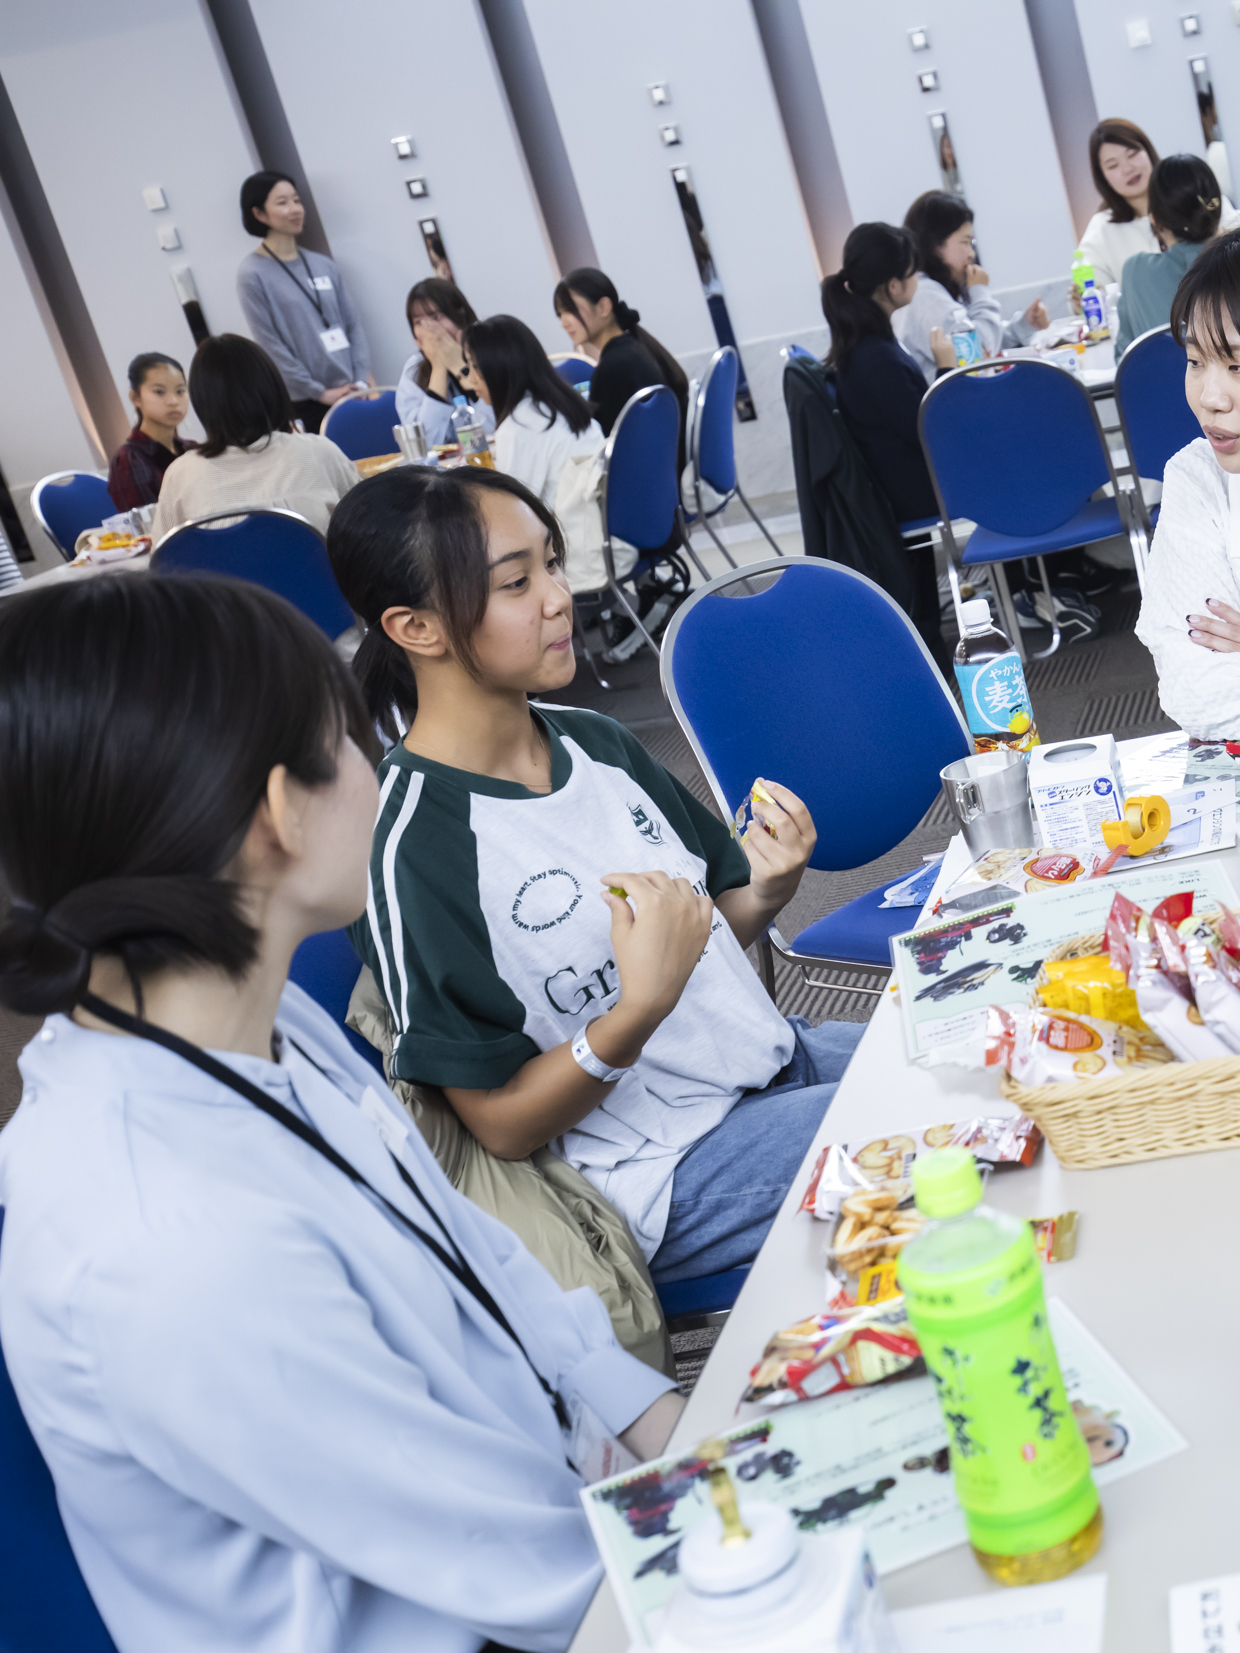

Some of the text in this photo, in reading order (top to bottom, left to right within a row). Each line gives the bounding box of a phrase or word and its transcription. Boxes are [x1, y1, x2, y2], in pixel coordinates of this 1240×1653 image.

[988, 662, 1022, 680] やかん
[568, 894, 583, 912] Your
[511, 912, 529, 931] warm
[530, 920, 557, 934] words
